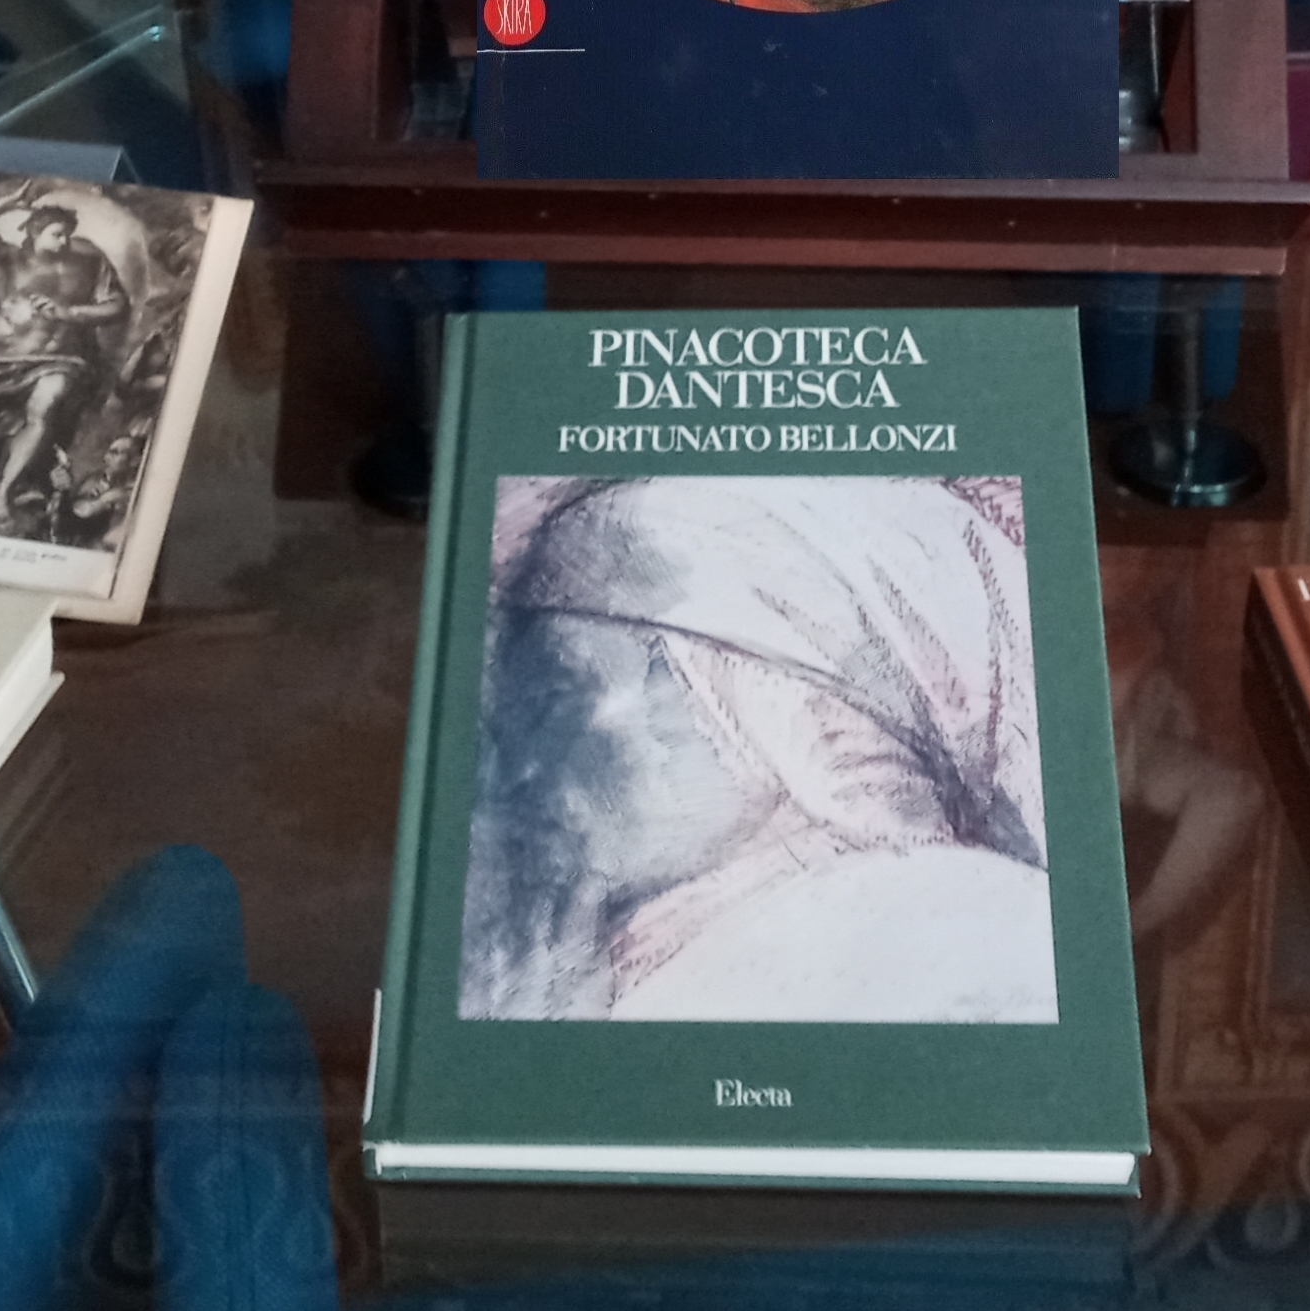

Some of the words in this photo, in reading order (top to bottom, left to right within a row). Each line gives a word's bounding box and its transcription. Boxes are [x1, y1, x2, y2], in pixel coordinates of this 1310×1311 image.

[588, 326, 928, 367] PINACOTECA
[614, 369, 901, 409] DANTESCA
[558, 424, 772, 453] FORTUNATO
[778, 424, 958, 452] BELLONZI
[714, 1078, 794, 1107] Electa
